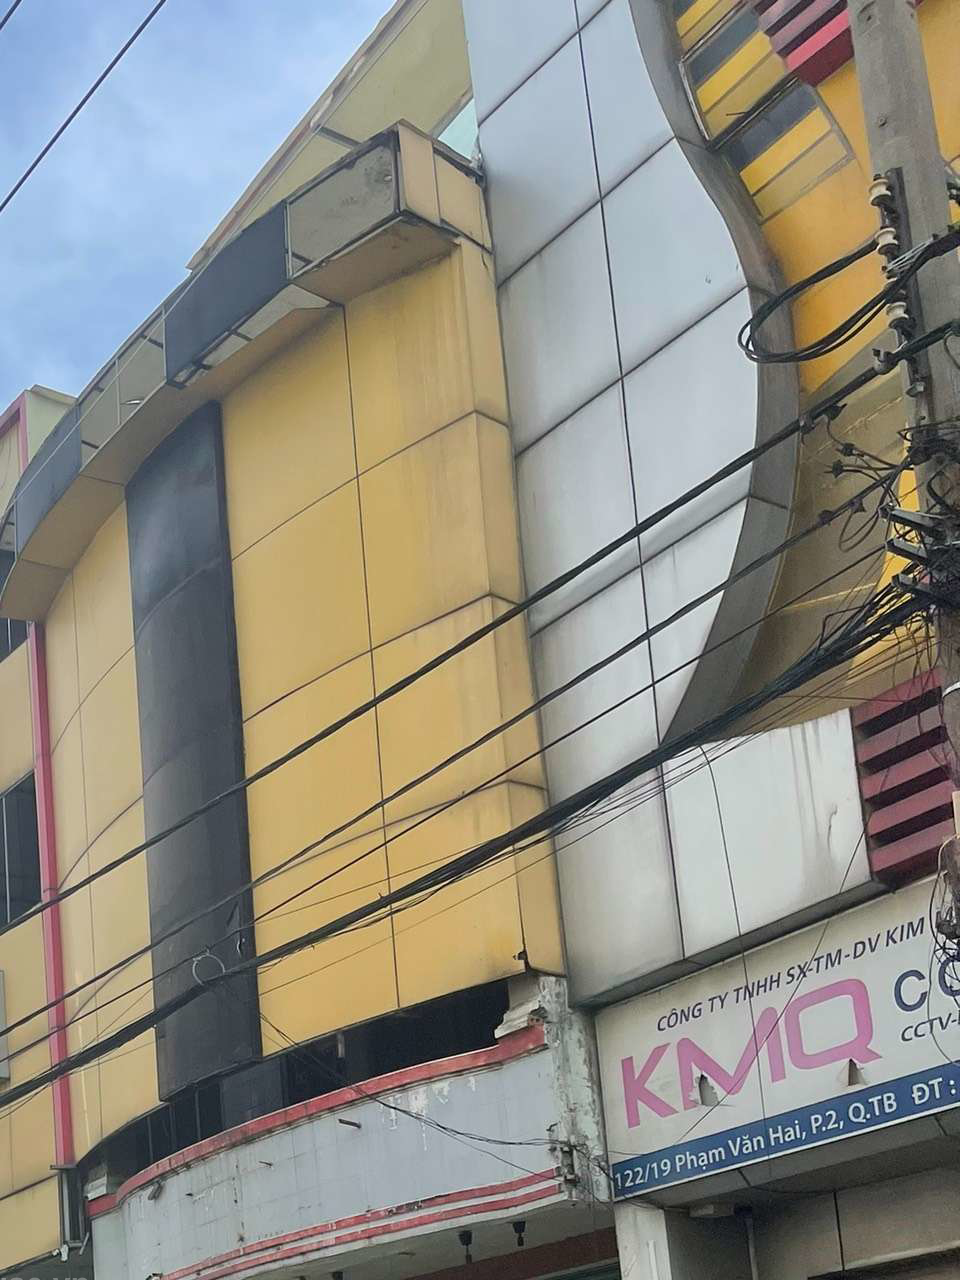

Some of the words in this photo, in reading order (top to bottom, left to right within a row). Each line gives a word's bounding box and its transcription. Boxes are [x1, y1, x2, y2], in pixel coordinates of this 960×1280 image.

[657, 1002, 702, 1031] CÔNG
[708, 991, 729, 1013] TY
[733, 972, 781, 1005] TNHH
[885, 917, 925, 947] KIM
[901, 1012, 960, 1042] CCTV-
[621, 978, 882, 1129] KMQ
[615, 1159, 672, 1190] 122/19
[676, 1147, 726, 1173] Phạm
[728, 1134, 765, 1157] Văn
[848, 1092, 897, 1123] Q.TB
